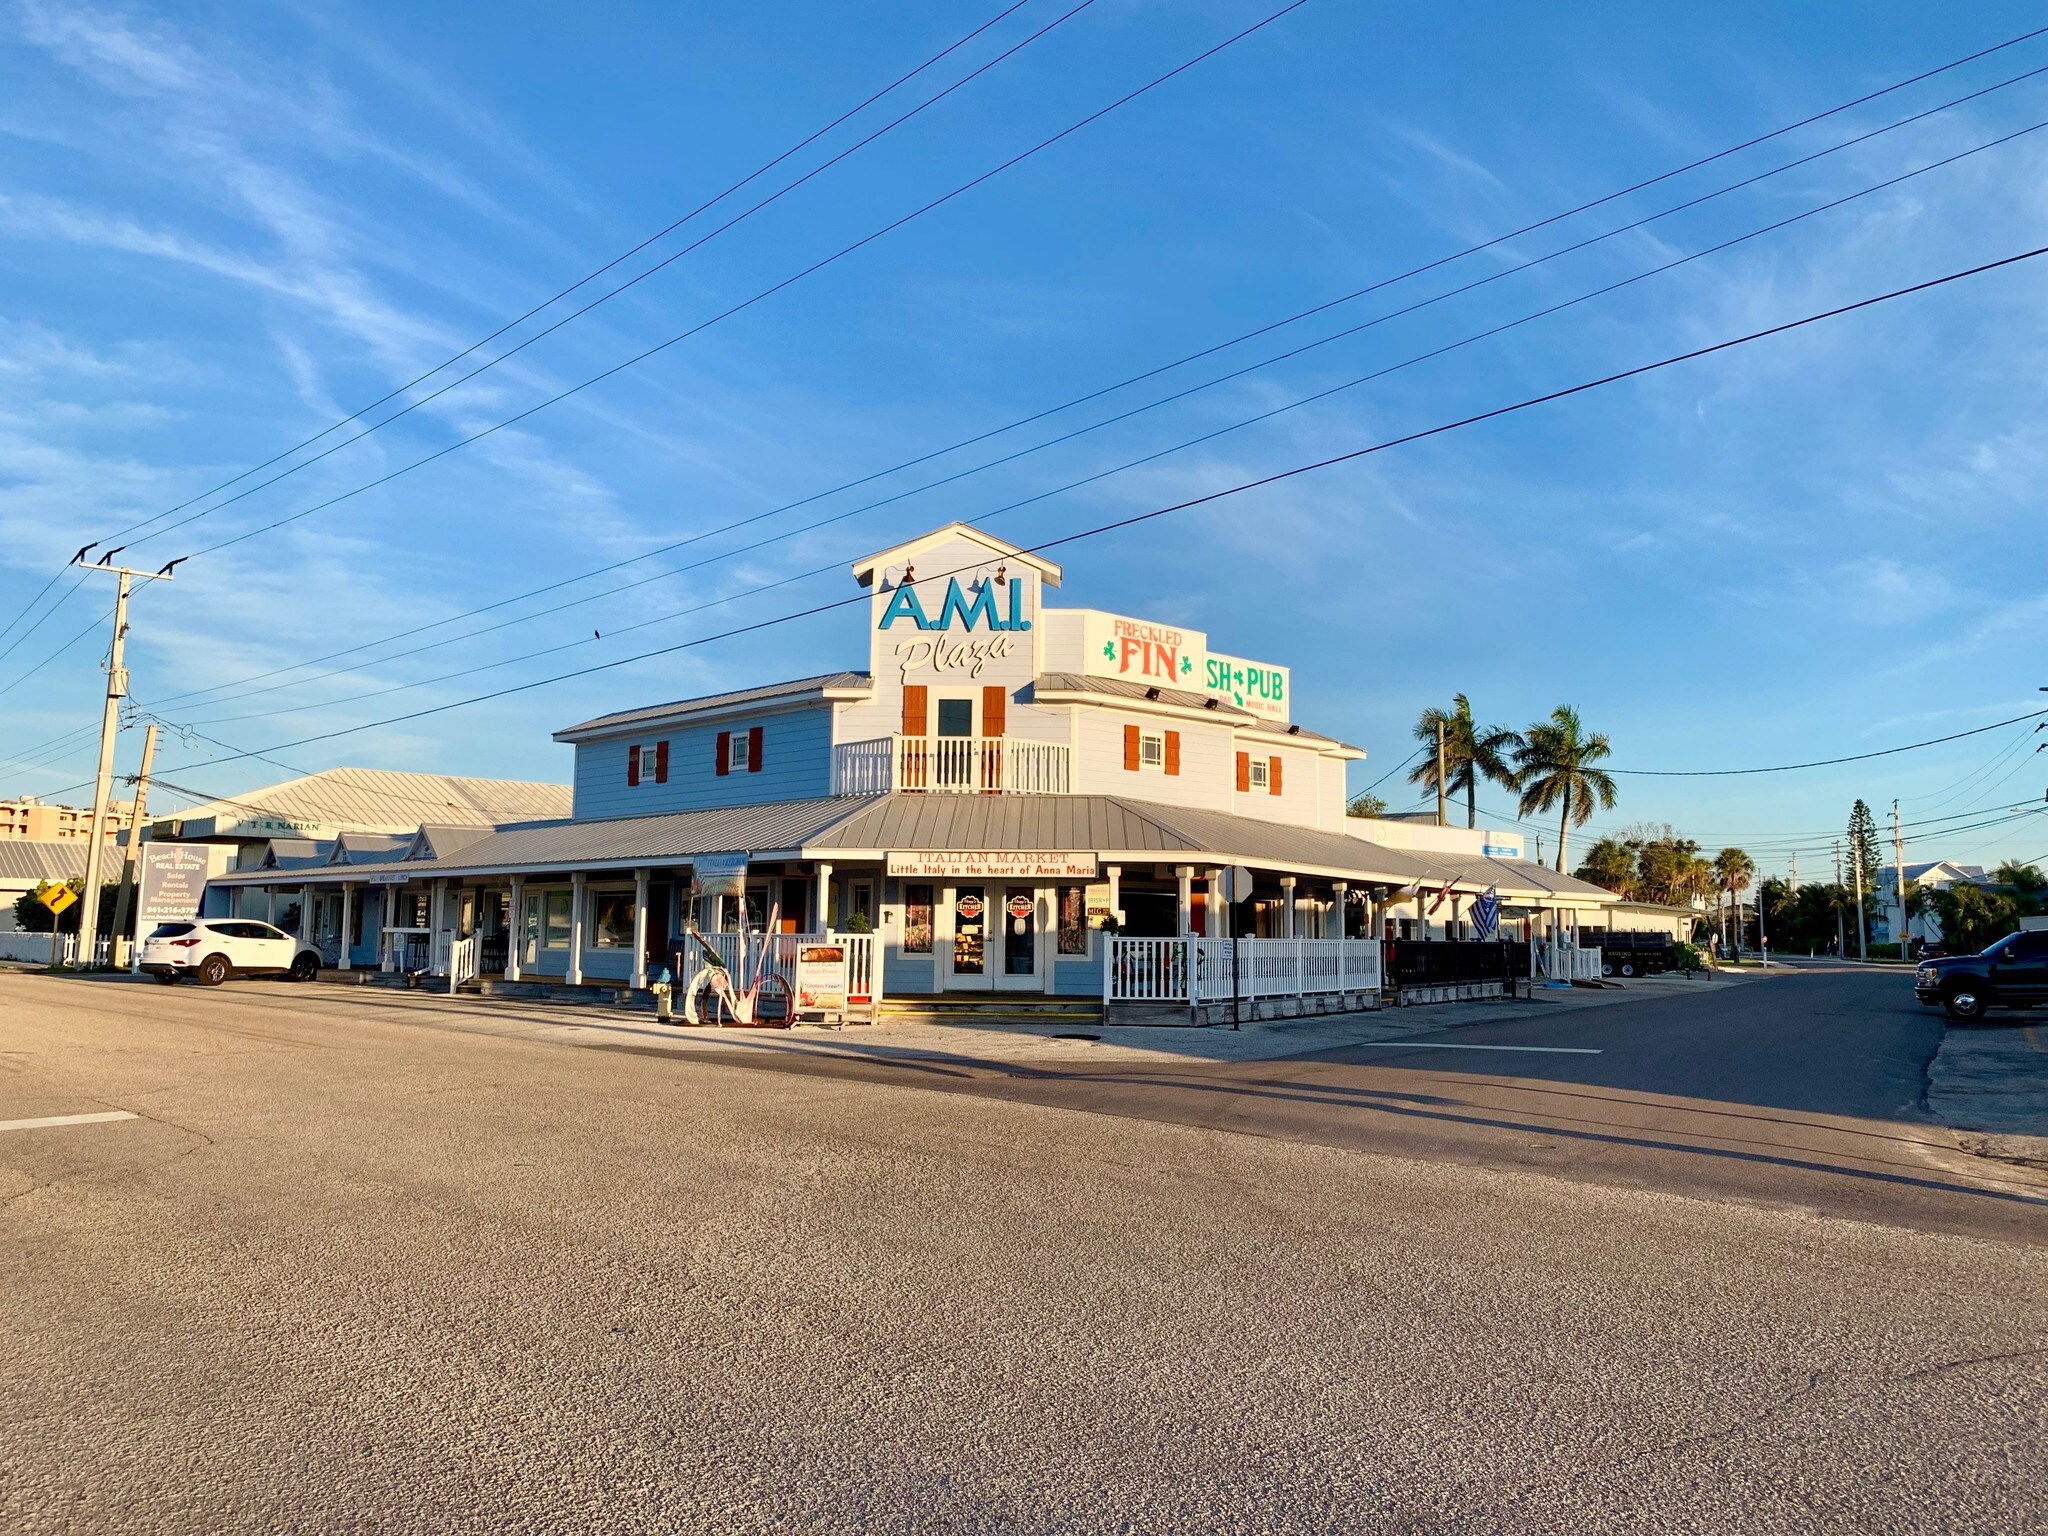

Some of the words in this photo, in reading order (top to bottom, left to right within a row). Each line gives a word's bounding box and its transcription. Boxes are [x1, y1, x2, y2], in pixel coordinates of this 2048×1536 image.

[1114, 619, 1182, 647] FRECKLED
[894, 632, 1016, 685] Plaza
[1119, 636, 1178, 684] FIN
[1246, 666, 1283, 701] PUB
[149, 851, 176, 864] Beach
[180, 850, 207, 865] House
[918, 852, 989, 863] ITALIAN
[995, 852, 1069, 864] MARKET
[155, 862, 174, 870] REAL
[175, 863, 200, 871] ESTATE
[890, 864, 918, 874] Little
[924, 864, 946, 876] Italy
[951, 865, 960, 874] in
[966, 864, 982, 874] the
[988, 864, 1014, 875] heart
[1020, 865, 1031, 875] of
[1035, 865, 1061, 875] Anna
[1066, 865, 1095, 875] Maria
[161, 881, 189, 889] Rentals
[150, 896, 198, 904] Management
[158, 890, 191, 899] Property
